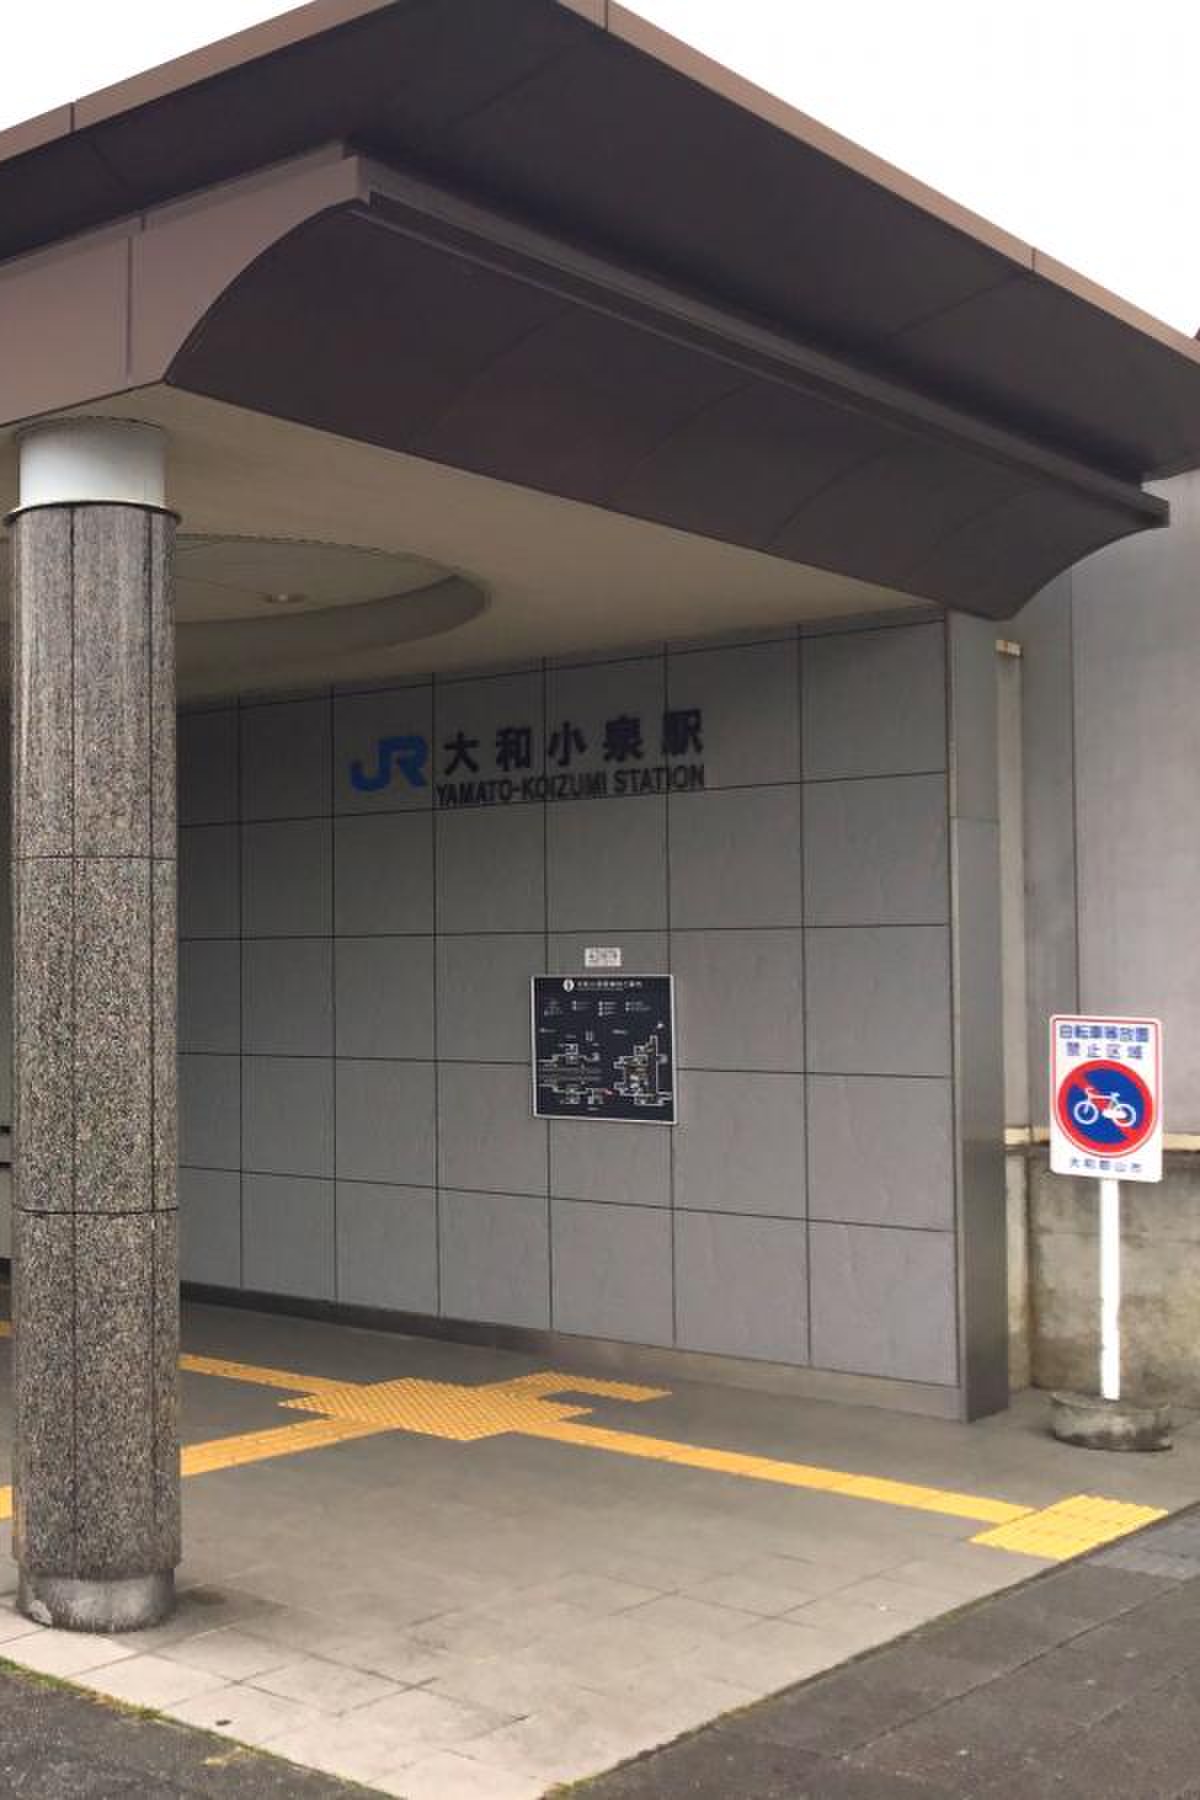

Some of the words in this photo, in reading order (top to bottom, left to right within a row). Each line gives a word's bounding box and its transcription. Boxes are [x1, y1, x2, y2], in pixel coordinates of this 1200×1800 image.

[349, 736, 429, 792] JR
[443, 709, 704, 776] 大和小泉駅
[436, 775, 608, 808] YAMATO-KOIZUMI
[614, 764, 704, 794] STATION
